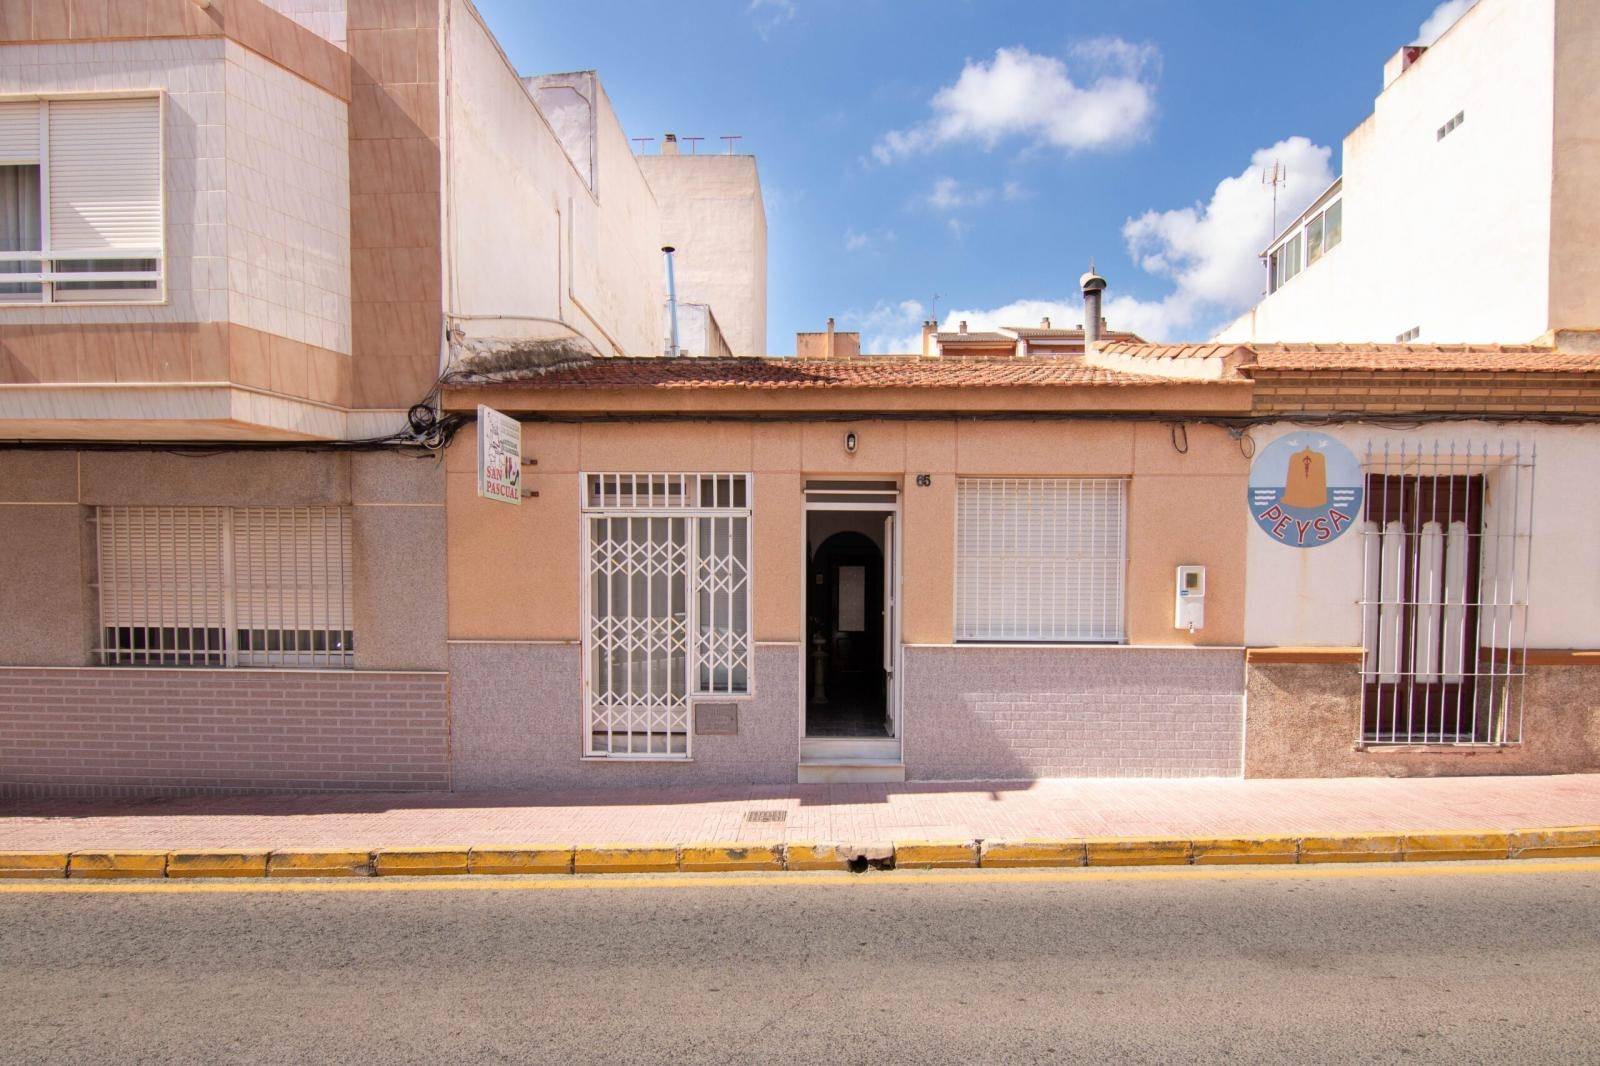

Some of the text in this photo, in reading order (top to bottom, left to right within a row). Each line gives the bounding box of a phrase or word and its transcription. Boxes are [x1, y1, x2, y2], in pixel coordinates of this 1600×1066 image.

[486, 465, 503, 481] SAN
[916, 474, 932, 487] 65
[486, 480, 518, 499] PASCUAL
[1259, 504, 1351, 544] PEYSA
